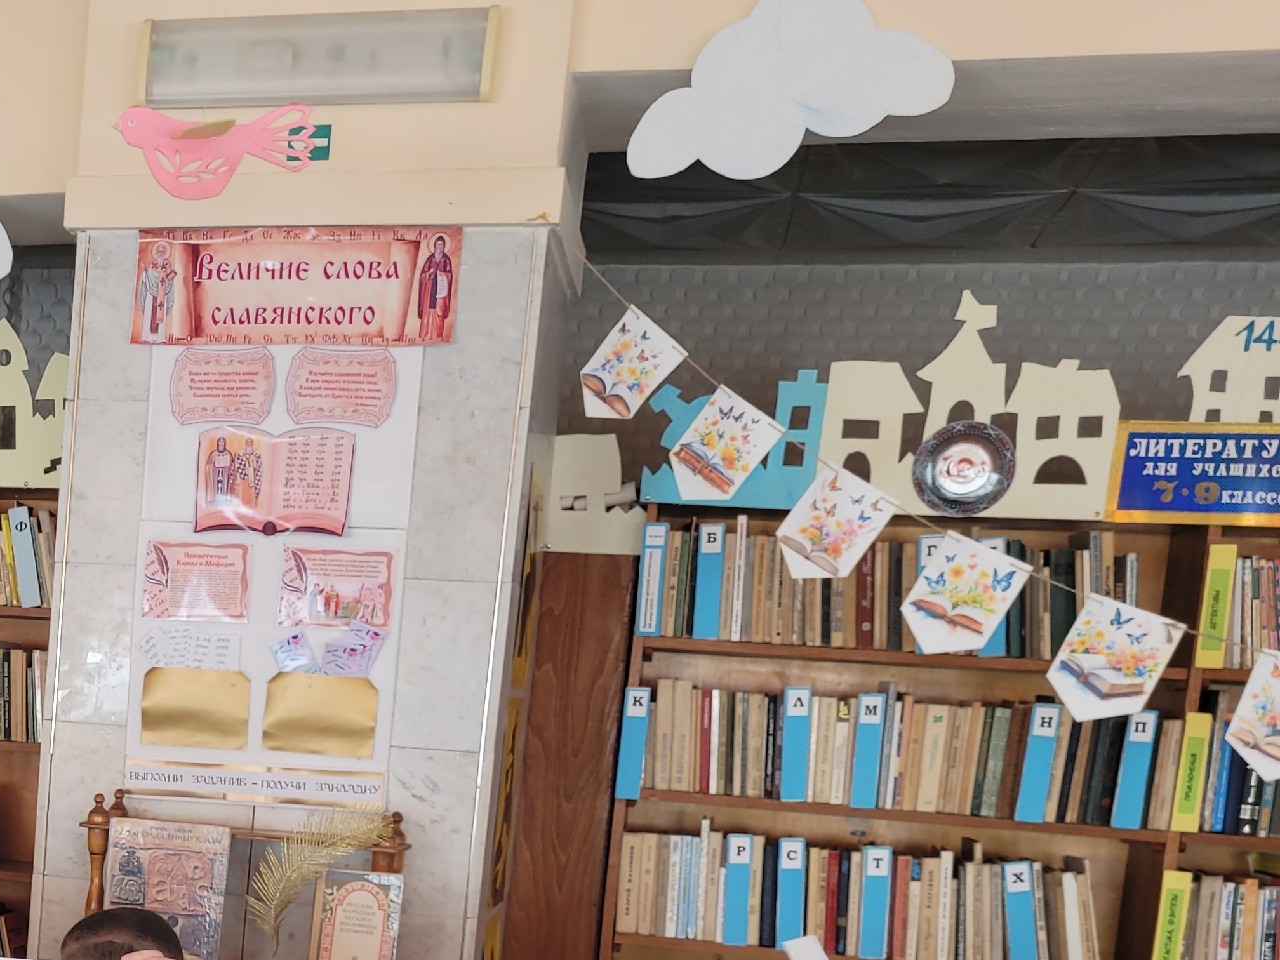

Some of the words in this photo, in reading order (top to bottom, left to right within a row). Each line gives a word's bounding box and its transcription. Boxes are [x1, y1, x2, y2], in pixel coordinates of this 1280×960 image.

[1142, 462, 1178, 476] ДЛЯ
[1221, 490, 1280, 505] КЛАСС
[15, 520, 27, 533] Ф
[706, 532, 717, 544] Б
[631, 696, 644, 707] К
[792, 697, 805, 707] Л
[865, 705, 878, 715] М
[1039, 716, 1053, 728] Н
[1134, 722, 1147, 733] П
[129, 771, 184, 783] ВЫПОЛНИ
[191, 775, 247, 787] ЗАДАНИЕ
[261, 779, 306, 791] ПОЛУЧИ
[315, 782, 381, 794] ЗАКЛАДКУ
[736, 845, 746, 856] Р
[786, 850, 798, 861] С
[872, 858, 884, 869] Т
[1012, 871, 1026, 884] Х
